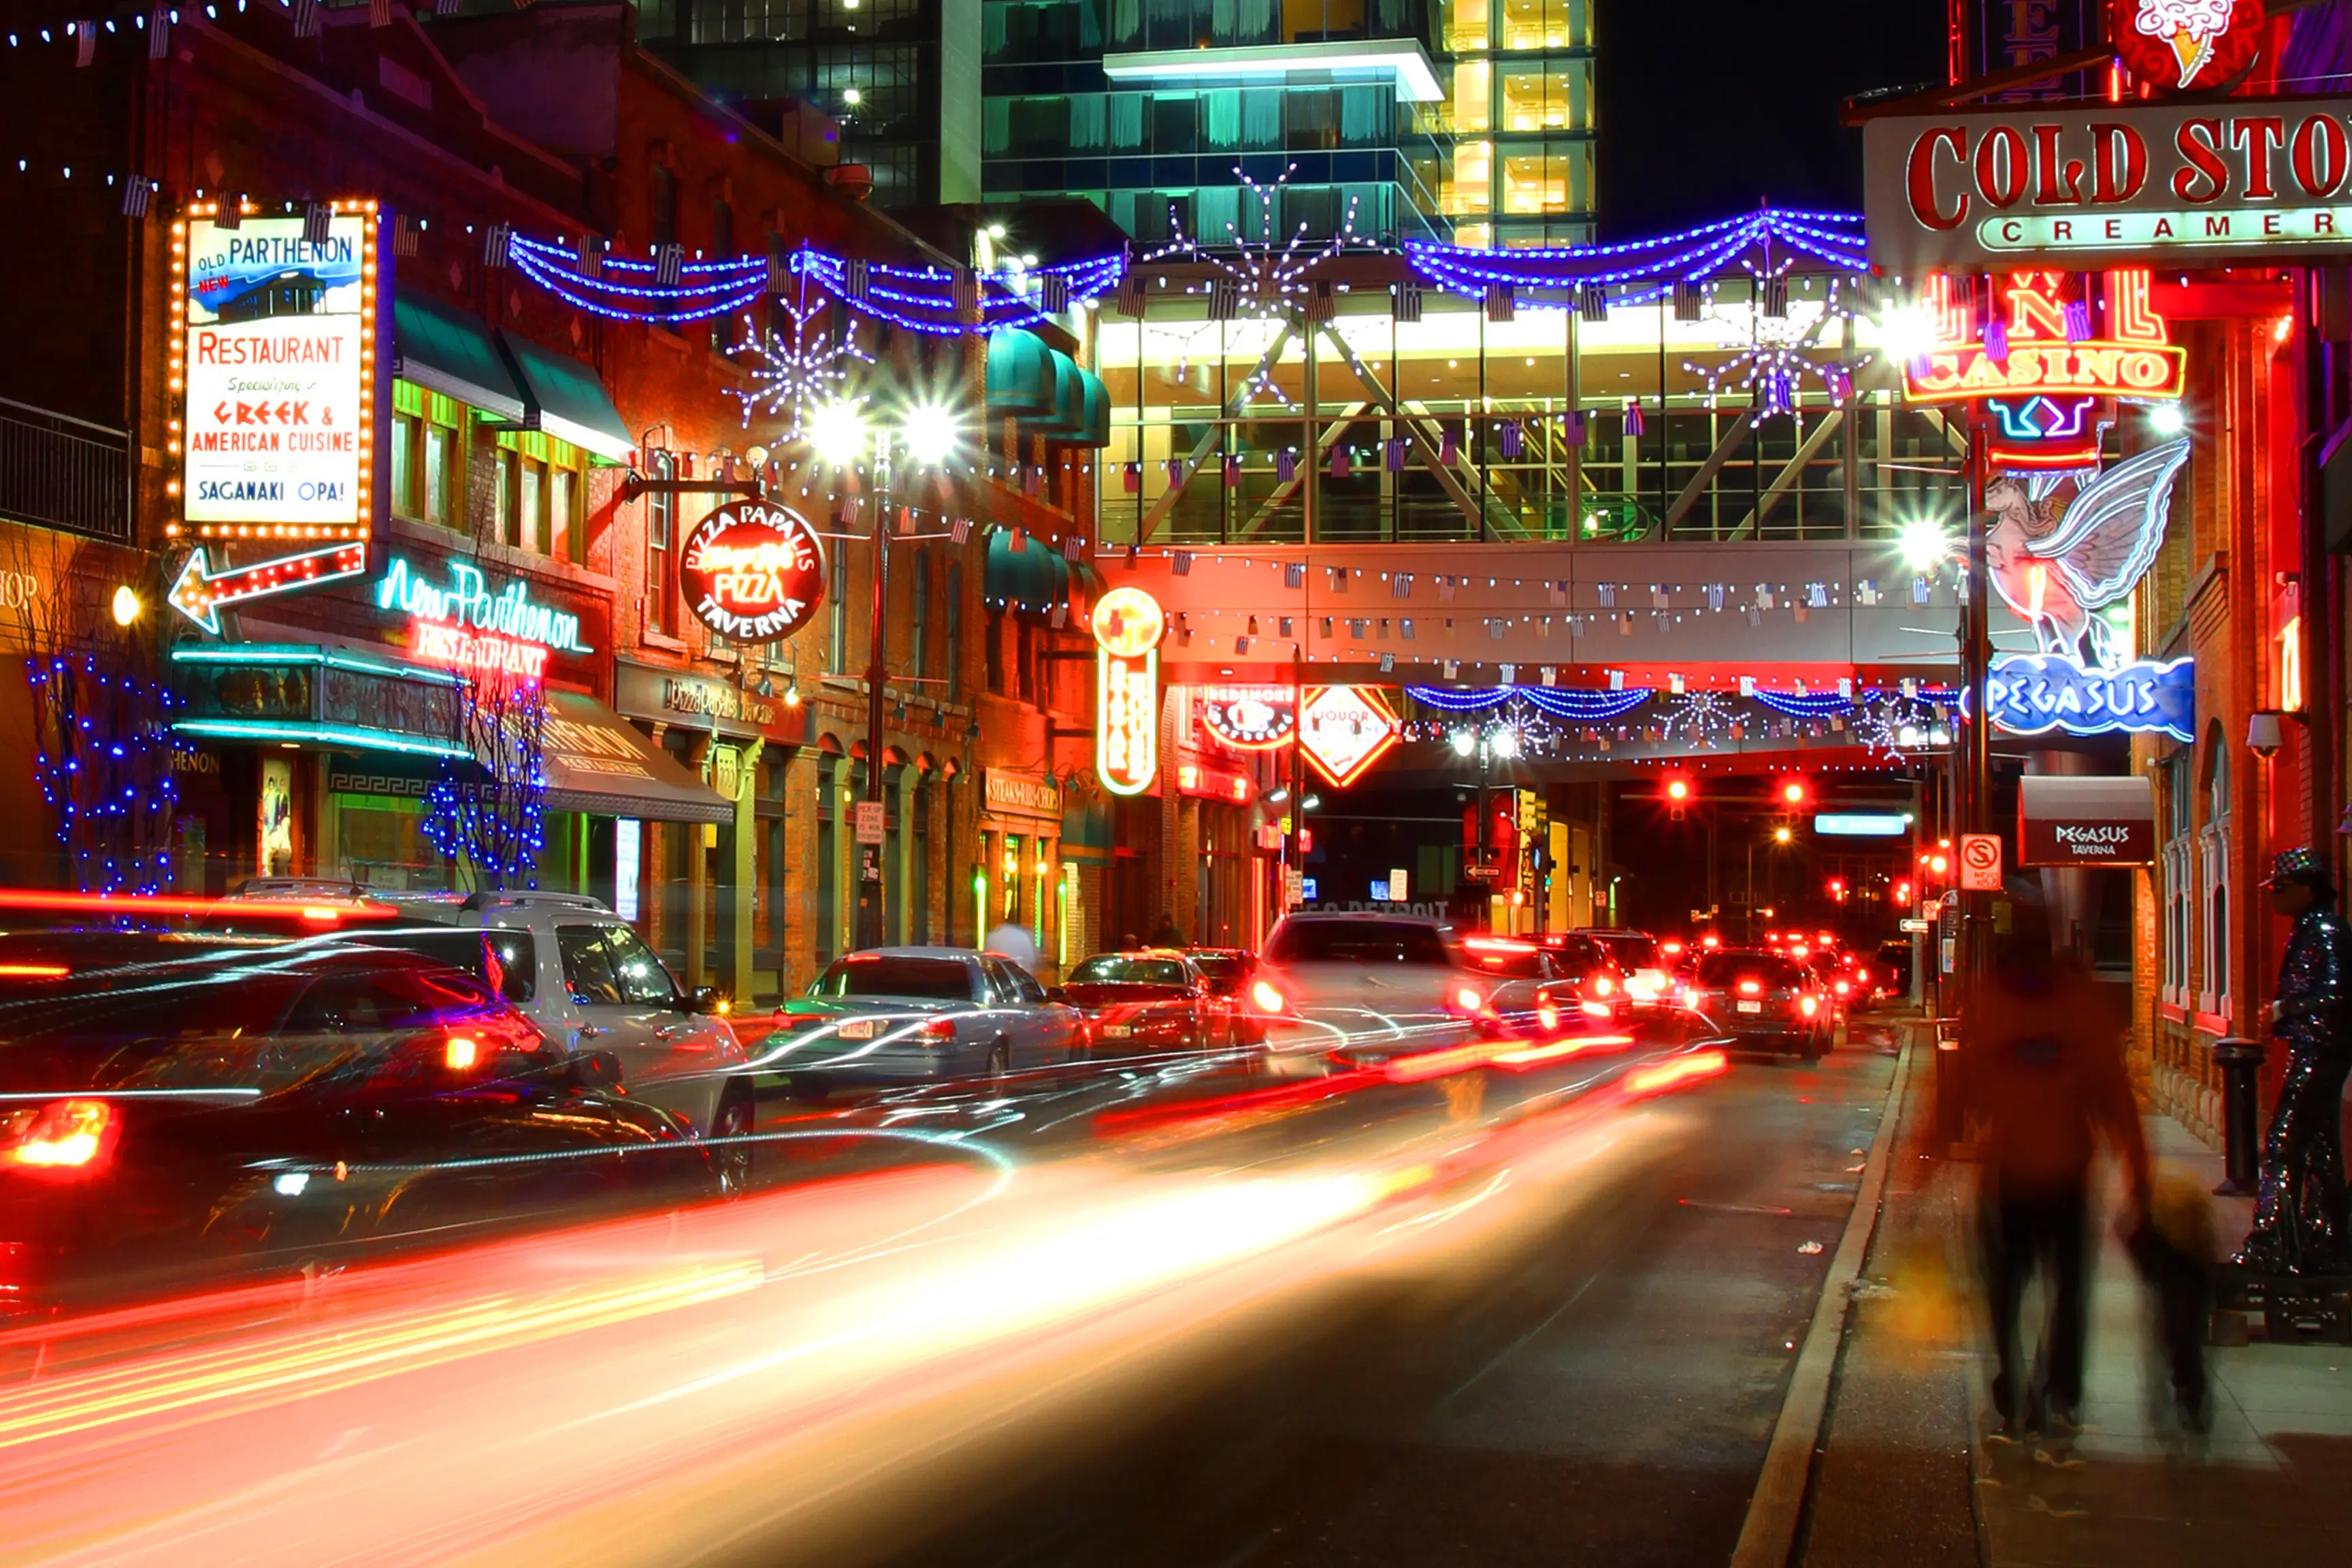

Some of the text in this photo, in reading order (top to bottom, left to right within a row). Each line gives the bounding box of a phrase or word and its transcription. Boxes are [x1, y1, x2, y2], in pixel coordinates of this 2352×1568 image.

[1907, 114, 2352, 231] COLD STO
[2002, 213, 2333, 242] CREAMER
[198, 235, 353, 271] OLD PARTHENON
[198, 275, 229, 293] NEW
[198, 331, 344, 364] RESTAURANT
[213, 400, 333, 426] GREEK &
[191, 431, 353, 452] AMERICAN CUISINE
[198, 480, 344, 502] SAGANAKI OPA!
[685, 512, 737, 570] PIZZA
[740, 505, 815, 572] PAPALIS
[714, 573, 785, 604] PIZZA
[380, 558, 595, 655] New Parthenon
[696, 593, 806, 638] TAVERNA
[416, 622, 547, 677] RESTAURANT
[1987, 678, 2157, 715] PEGASUS
[557, 756, 649, 777] RESTAURANT
[2055, 826, 2129, 843] PEGASUS
[2071, 845, 2116, 855] TAVERNA
